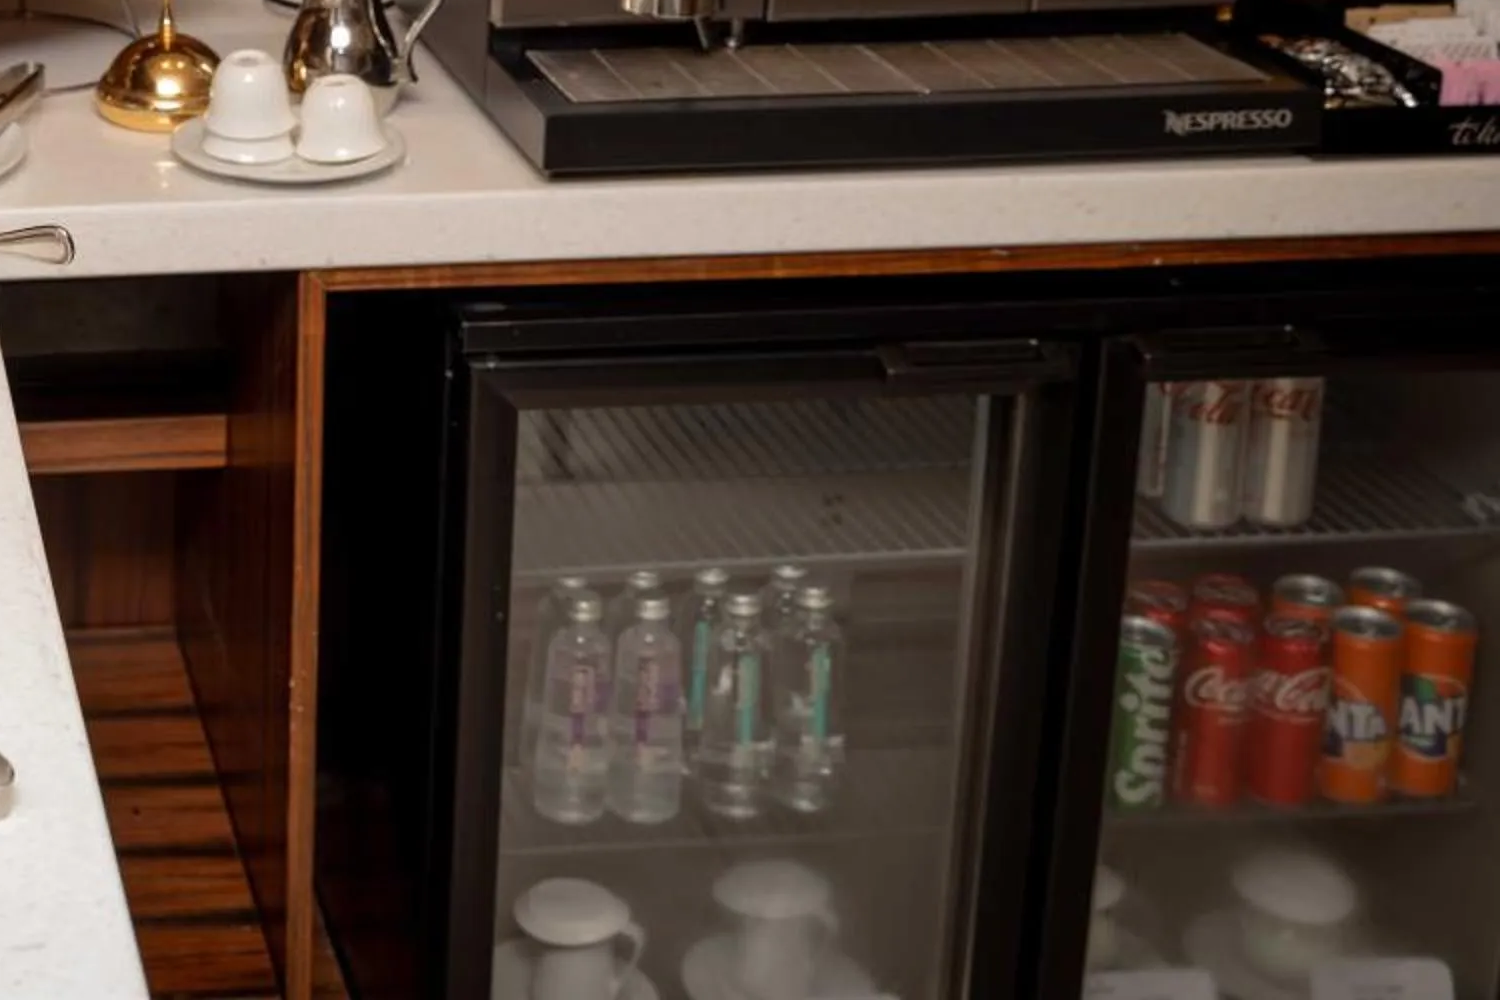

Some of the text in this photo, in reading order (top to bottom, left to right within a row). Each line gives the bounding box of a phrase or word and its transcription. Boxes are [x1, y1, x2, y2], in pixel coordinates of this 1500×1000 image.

[1161, 108, 1294, 137] NESPRESSO
[1327, 699, 1387, 741] NTA
[1399, 694, 1467, 738] ANT
